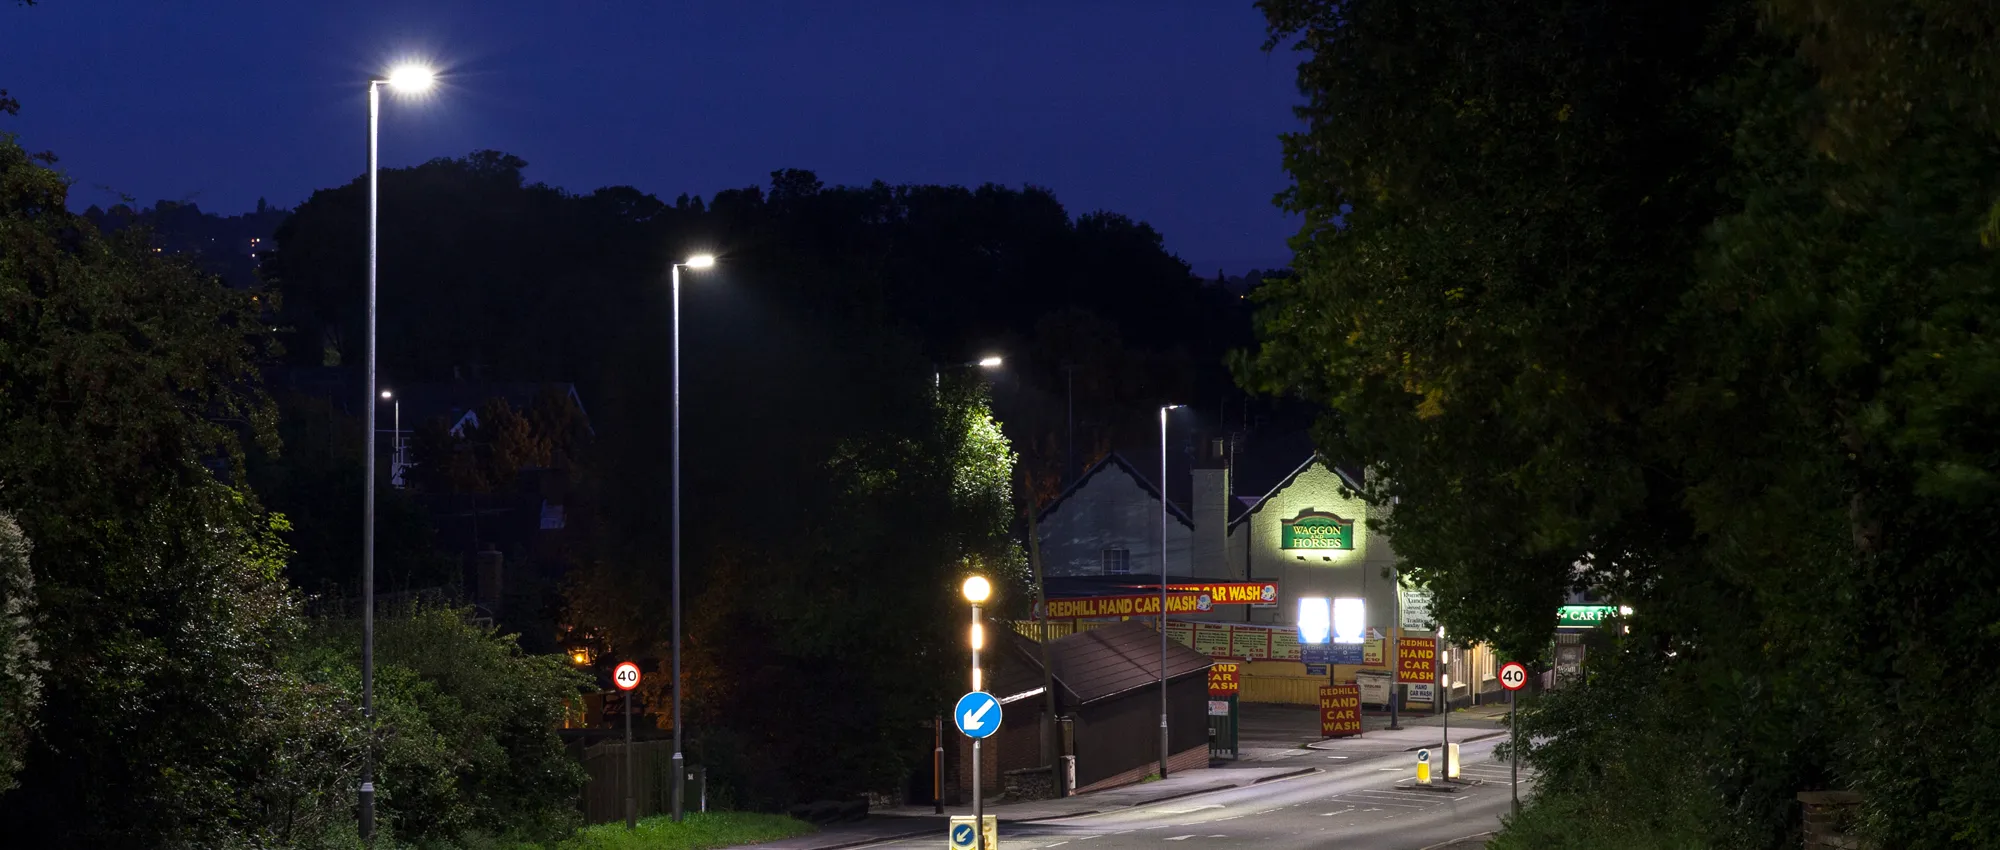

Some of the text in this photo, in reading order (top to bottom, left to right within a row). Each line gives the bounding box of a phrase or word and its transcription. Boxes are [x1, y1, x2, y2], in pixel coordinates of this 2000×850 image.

[1293, 526, 1342, 535] WAGGON
[1293, 538, 1342, 548] HORSES
[1229, 585, 1261, 601] WASH
[1049, 595, 1197, 617] REDHILL HAND CAR WASH
[1570, 611, 1596, 621] CAR
[1400, 639, 1435, 647] REDHILL
[1400, 649, 1434, 659] HAND
[1211, 664, 1237, 672] AND
[1404, 660, 1430, 670] CAR
[617, 671, 637, 681] 40
[1208, 673, 1232, 681] AR
[1400, 670, 1434, 680] WASH
[1502, 670, 1523, 682] 40
[1208, 682, 1238, 690] ASH
[1320, 687, 1358, 696] REDHILL
[1321, 697, 1358, 708] HAND
[1327, 710, 1355, 720] CAR
[1323, 721, 1360, 731] WASH
